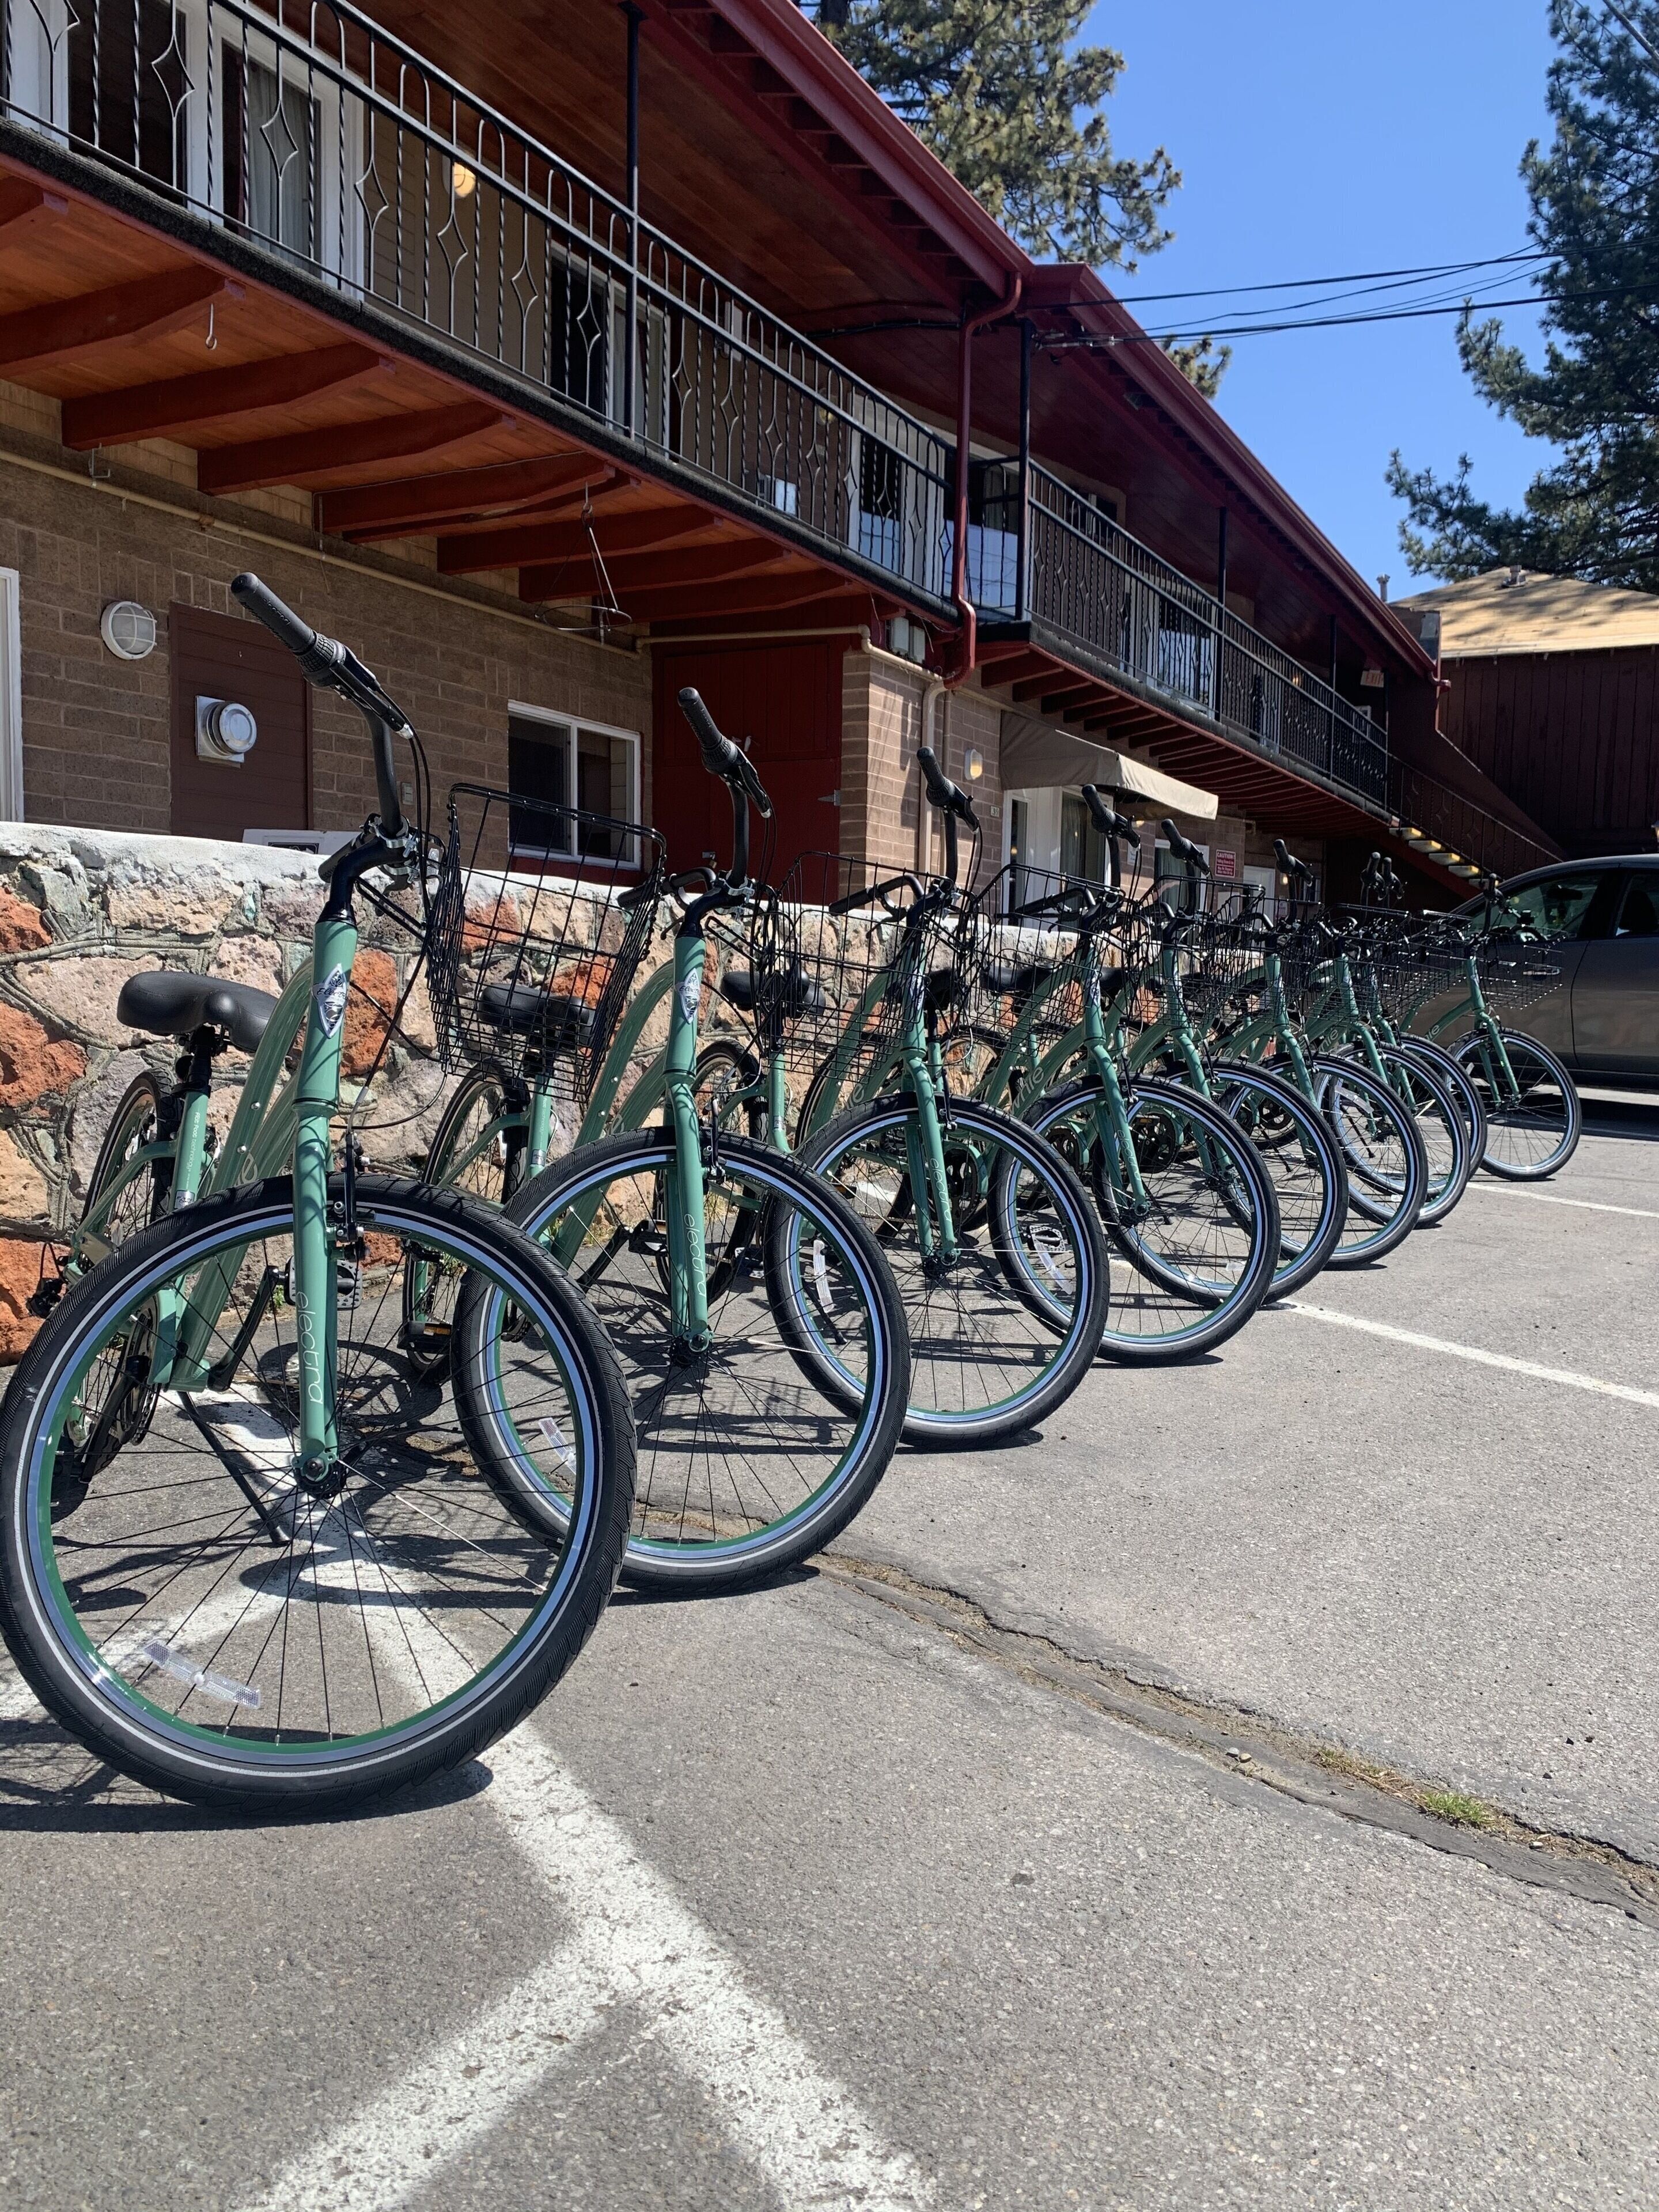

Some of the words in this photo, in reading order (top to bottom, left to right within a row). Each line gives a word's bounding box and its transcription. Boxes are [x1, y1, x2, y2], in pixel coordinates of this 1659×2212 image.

[930, 1158, 952, 1222] electra
[684, 1213, 707, 1298] electra
[295, 1291, 324, 1405] electra
